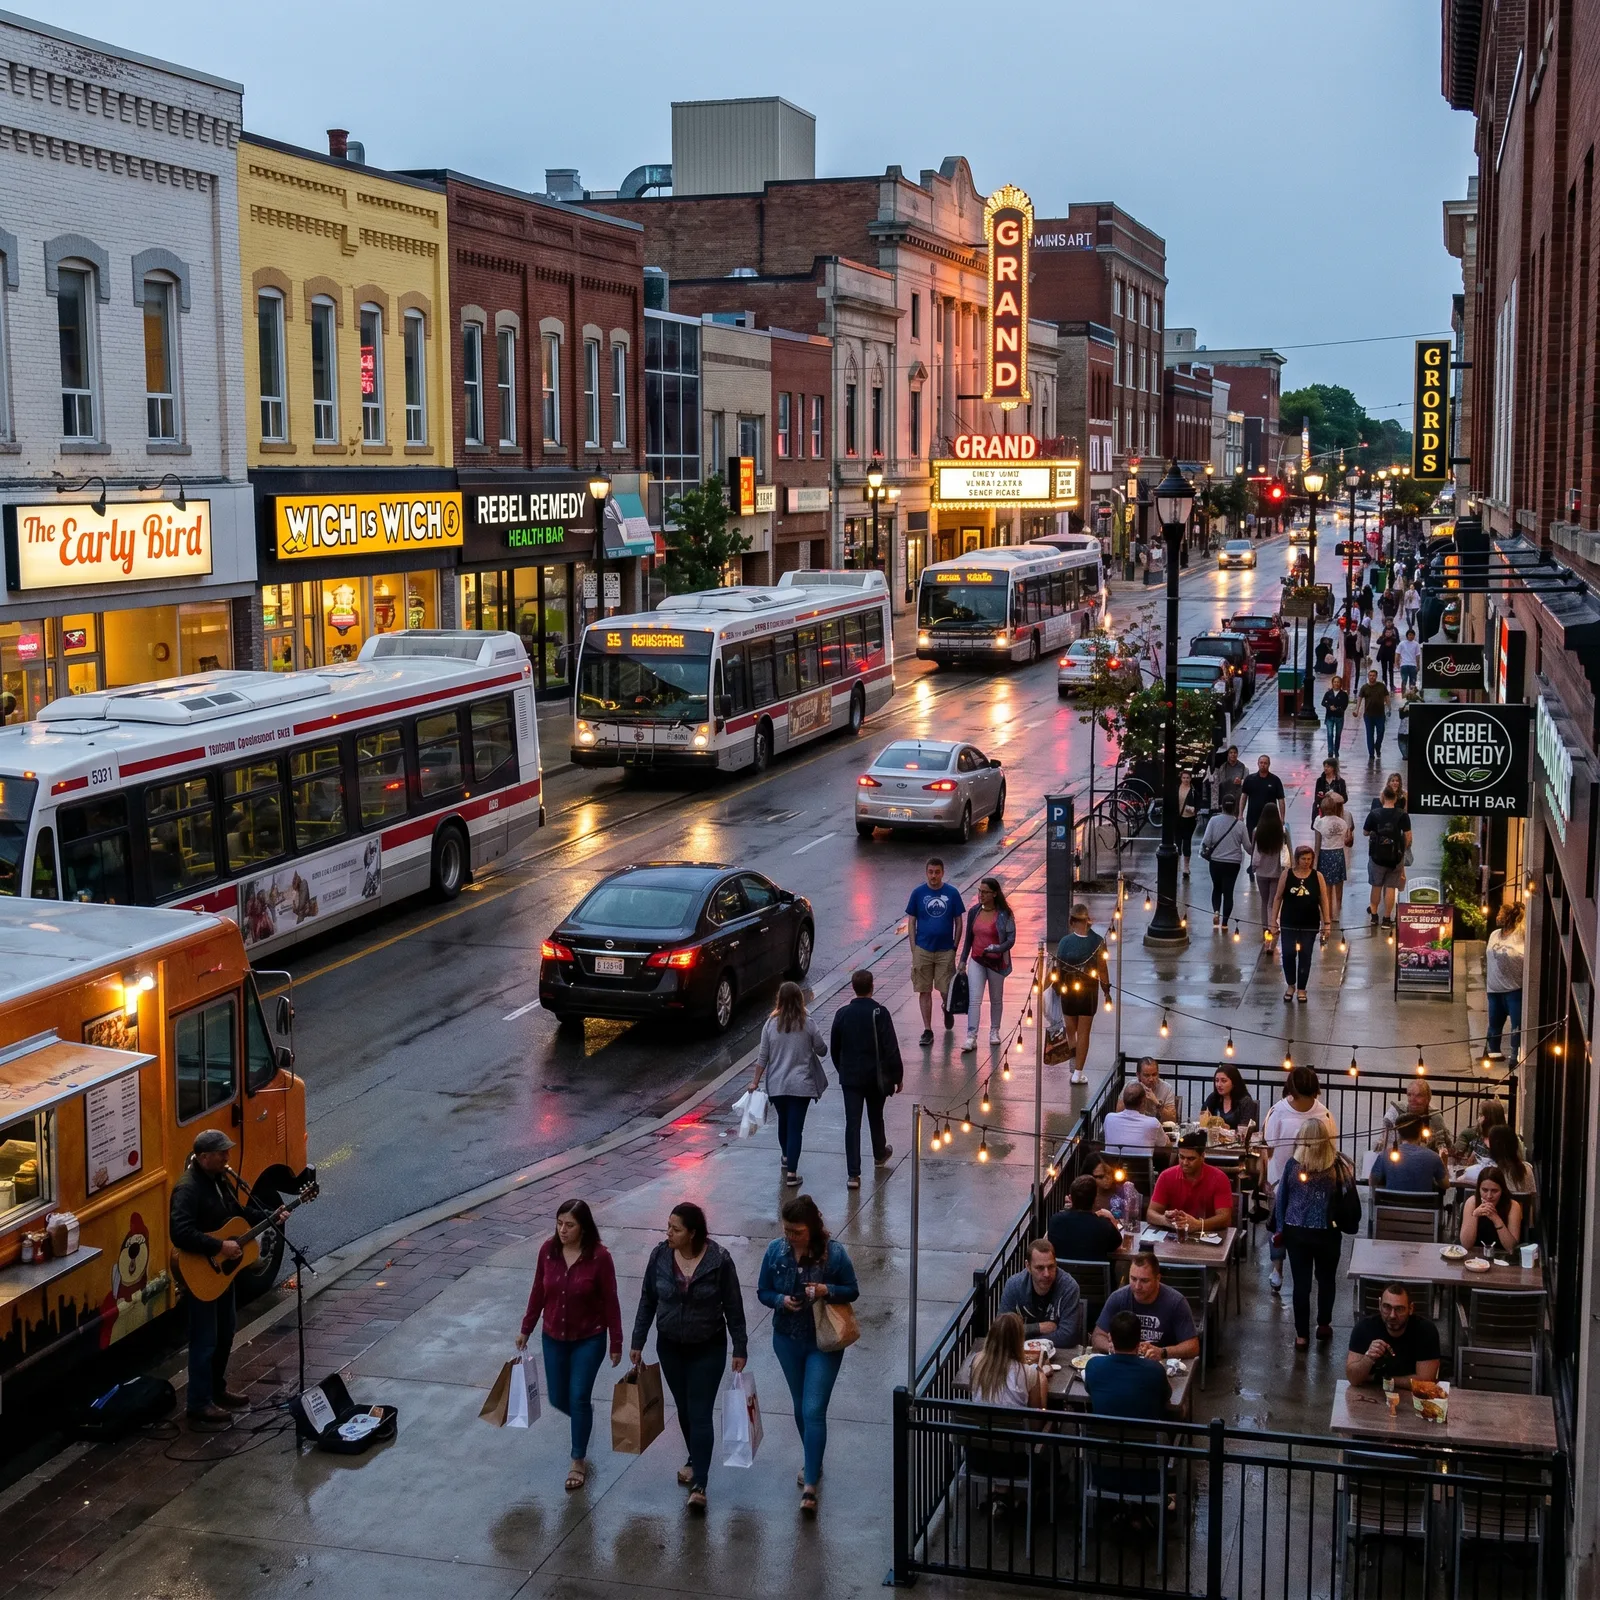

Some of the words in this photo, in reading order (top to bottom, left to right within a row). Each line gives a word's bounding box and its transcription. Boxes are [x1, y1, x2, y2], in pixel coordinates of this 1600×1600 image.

[995, 220, 1020, 387] GRAND
[1422, 348, 1441, 473] GRORDS
[955, 435, 1036, 459] GRAND
[477, 494, 528, 524] REBEL
[530, 492, 586, 521] REMEDY
[284, 503, 358, 547] WICH
[361, 511, 377, 538] IS
[379, 501, 442, 543] WICH
[23, 516, 56, 544] The
[59, 514, 136, 574] Early
[143, 514, 203, 559] Bird
[508, 527, 543, 547] HEALTH
[545, 526, 564, 543] BAR
[1443, 723, 1498, 743] REBEL
[1434, 745, 1505, 765] REMEDY
[1421, 794, 1480, 808] HEALTH
[1484, 796, 1516, 809] BAR
[1053, 807, 1064, 821] P
